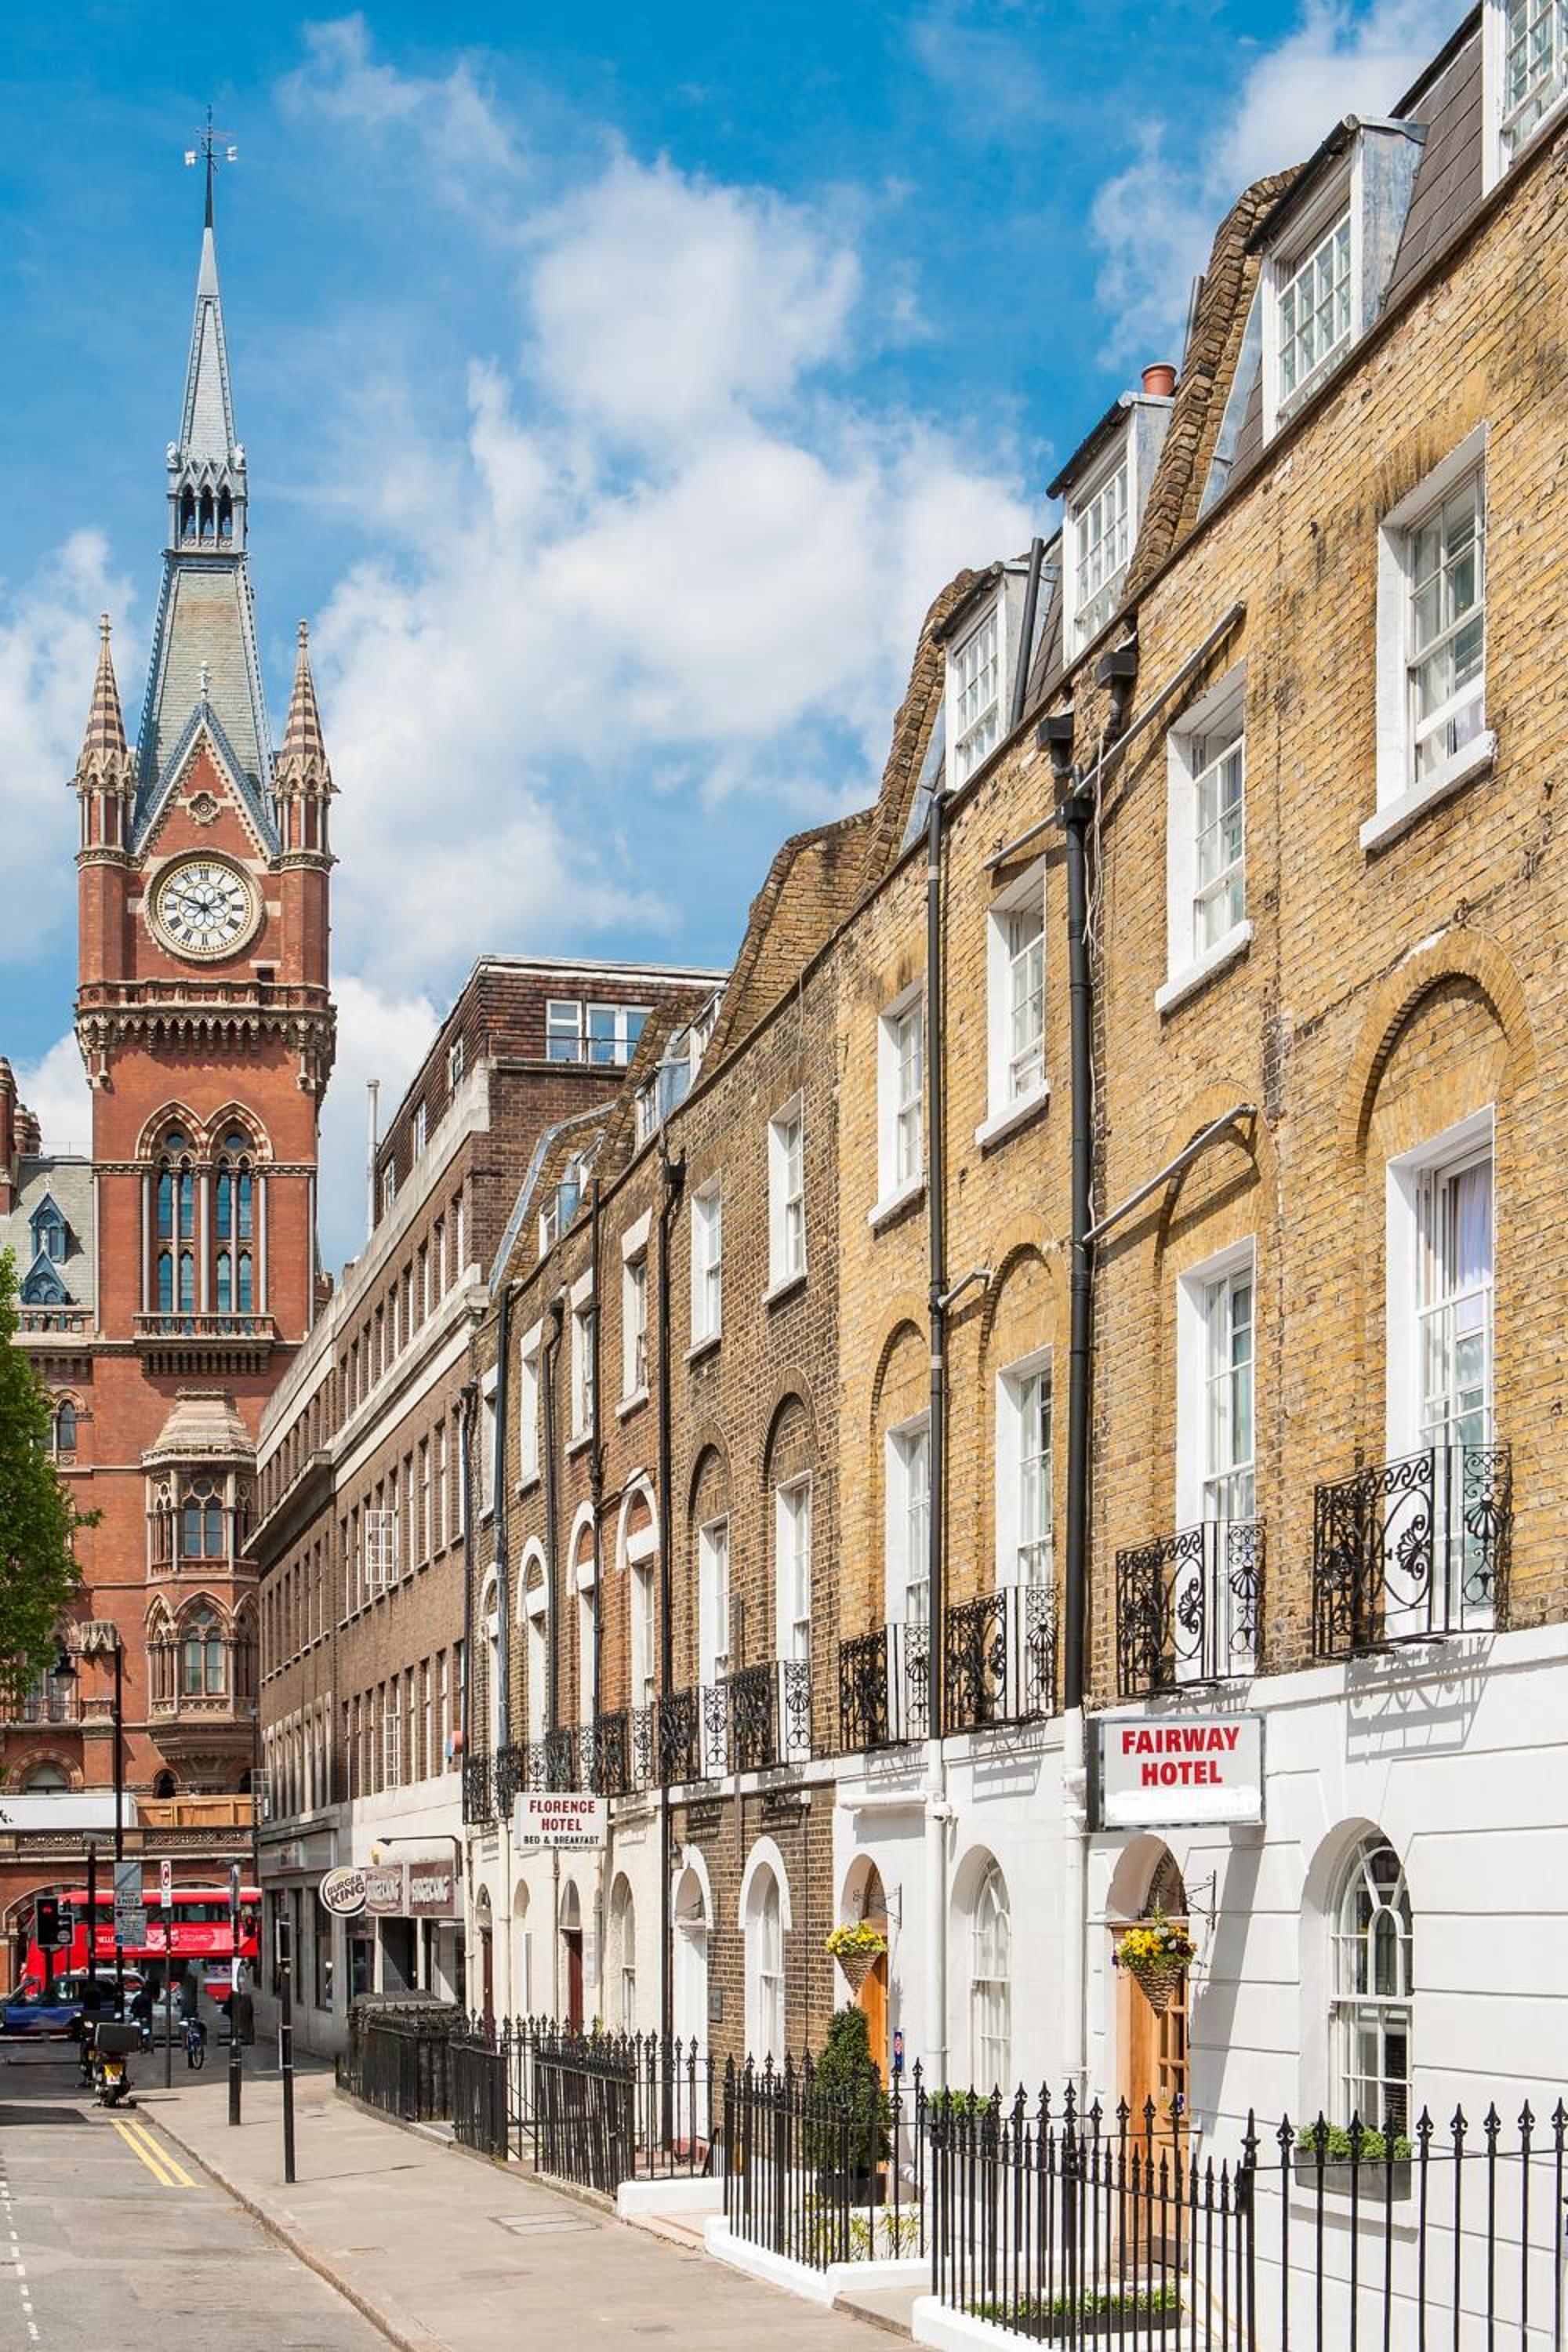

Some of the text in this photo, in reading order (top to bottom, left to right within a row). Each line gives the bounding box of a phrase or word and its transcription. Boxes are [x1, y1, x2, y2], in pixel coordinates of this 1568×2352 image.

[1122, 1727, 1240, 1755] FAIRWAY
[1142, 1761, 1223, 1786] HOTEL
[529, 1800, 595, 1813] FLORENCE
[542, 1818, 583, 1831] HOTEL
[524, 1835, 599, 1844] BED & BREAKFAST
[327, 1875, 363, 1896] BURGER
[330, 1882, 365, 1907] KING
